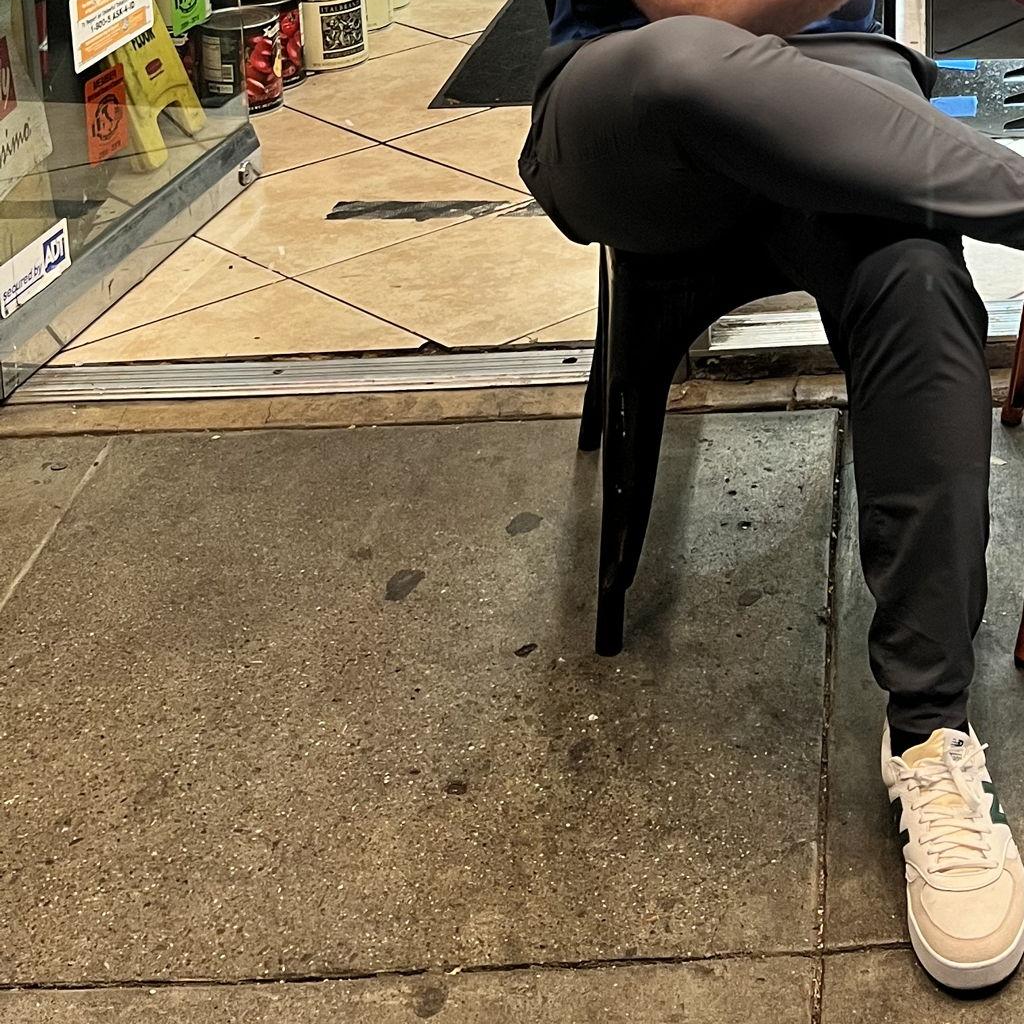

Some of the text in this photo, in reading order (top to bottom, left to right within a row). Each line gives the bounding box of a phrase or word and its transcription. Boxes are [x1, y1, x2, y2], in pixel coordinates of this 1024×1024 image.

[3, 236, 65, 301] secured by ADT
